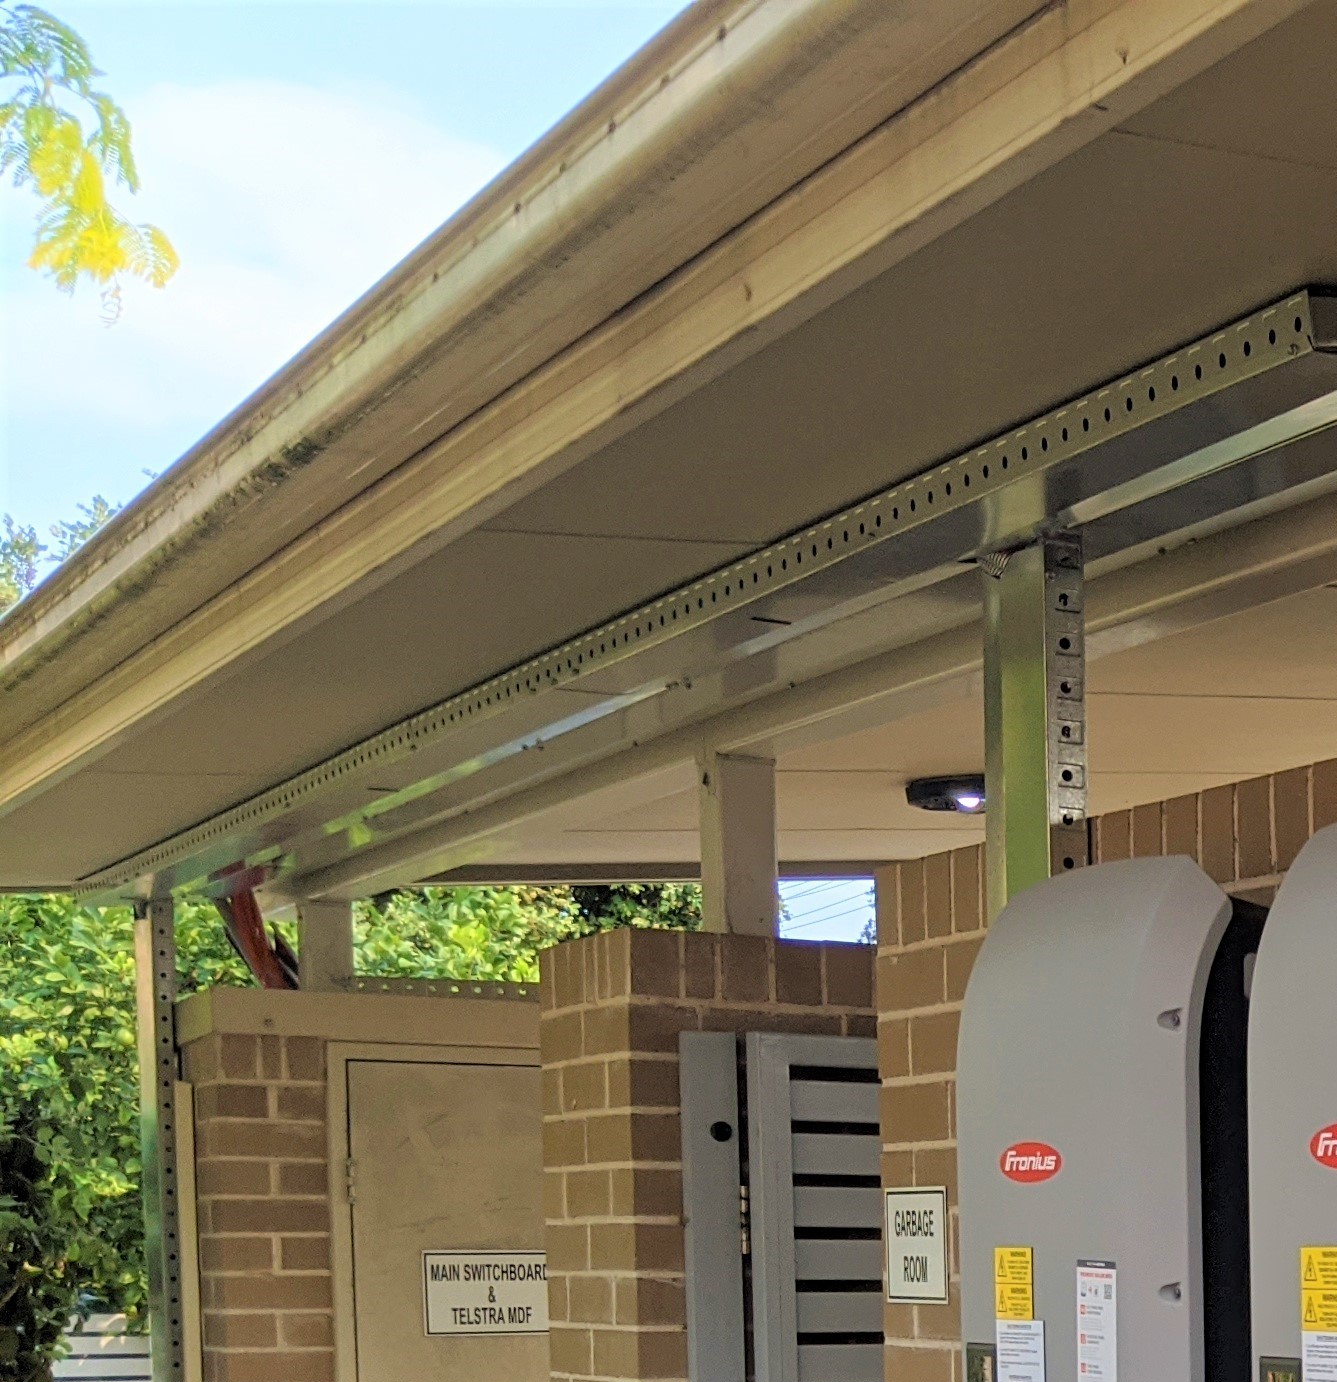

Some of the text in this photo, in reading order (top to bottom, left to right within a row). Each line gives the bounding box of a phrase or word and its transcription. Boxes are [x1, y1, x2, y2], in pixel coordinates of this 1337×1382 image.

[1004, 1150, 1057, 1172] Fronius
[894, 1209, 935, 1237] GARBAGE
[430, 1264, 460, 1282] MAIN
[903, 1255, 928, 1283] ROOM
[488, 1285, 497, 1303] &
[452, 1306, 533, 1325] TELSTRA MDF
